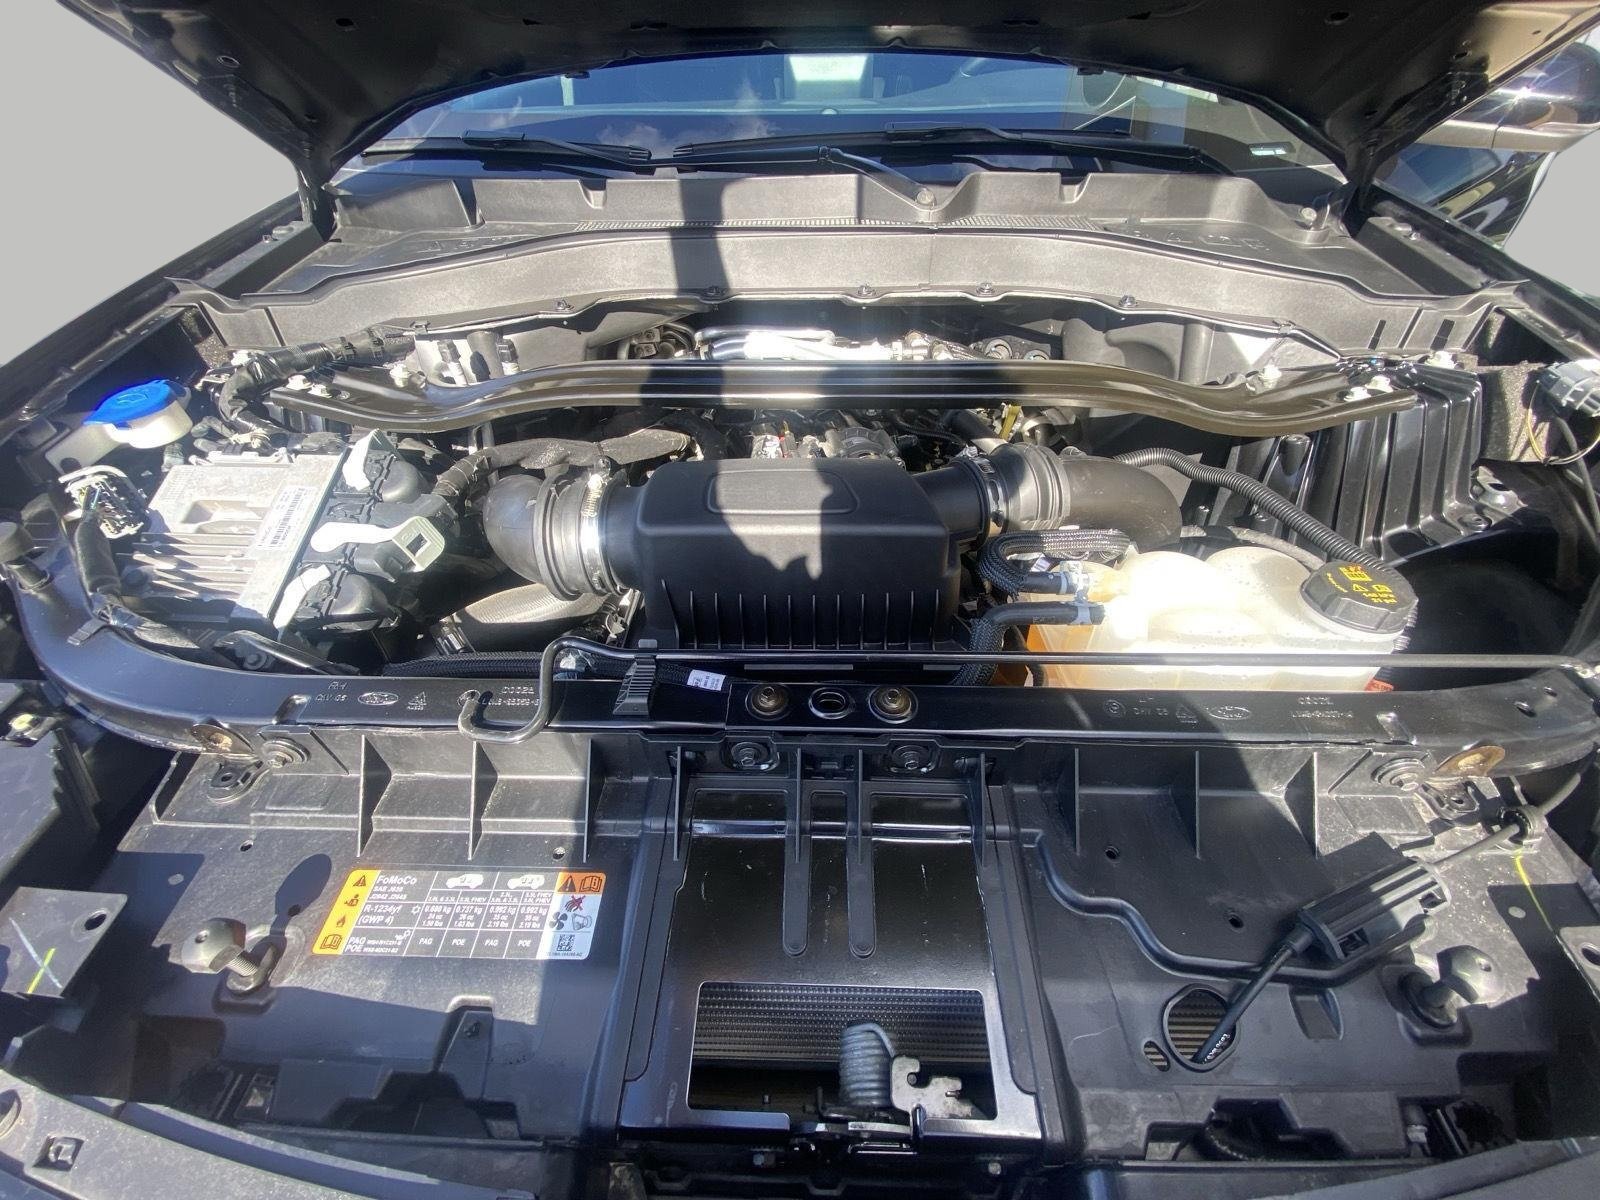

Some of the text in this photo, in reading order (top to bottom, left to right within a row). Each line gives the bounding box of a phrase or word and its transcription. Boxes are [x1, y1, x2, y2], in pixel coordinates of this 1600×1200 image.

[376, 875, 418, 885] FoMoCo
[363, 904, 403, 915] R-1234yf
[443, 905, 452, 915] kg
[474, 905, 483, 915] kg
[507, 905, 517, 915] kg
[539, 906, 549, 916] kg
[358, 915, 395, 926] (GWP 4)
[348, 937, 366, 945] PAG
[418, 937, 433, 945] PAG
[451, 938, 466, 946] POE
[484, 939, 499, 947] PAG
[517, 939, 532, 947] POE
[344, 944, 364, 953] POE
